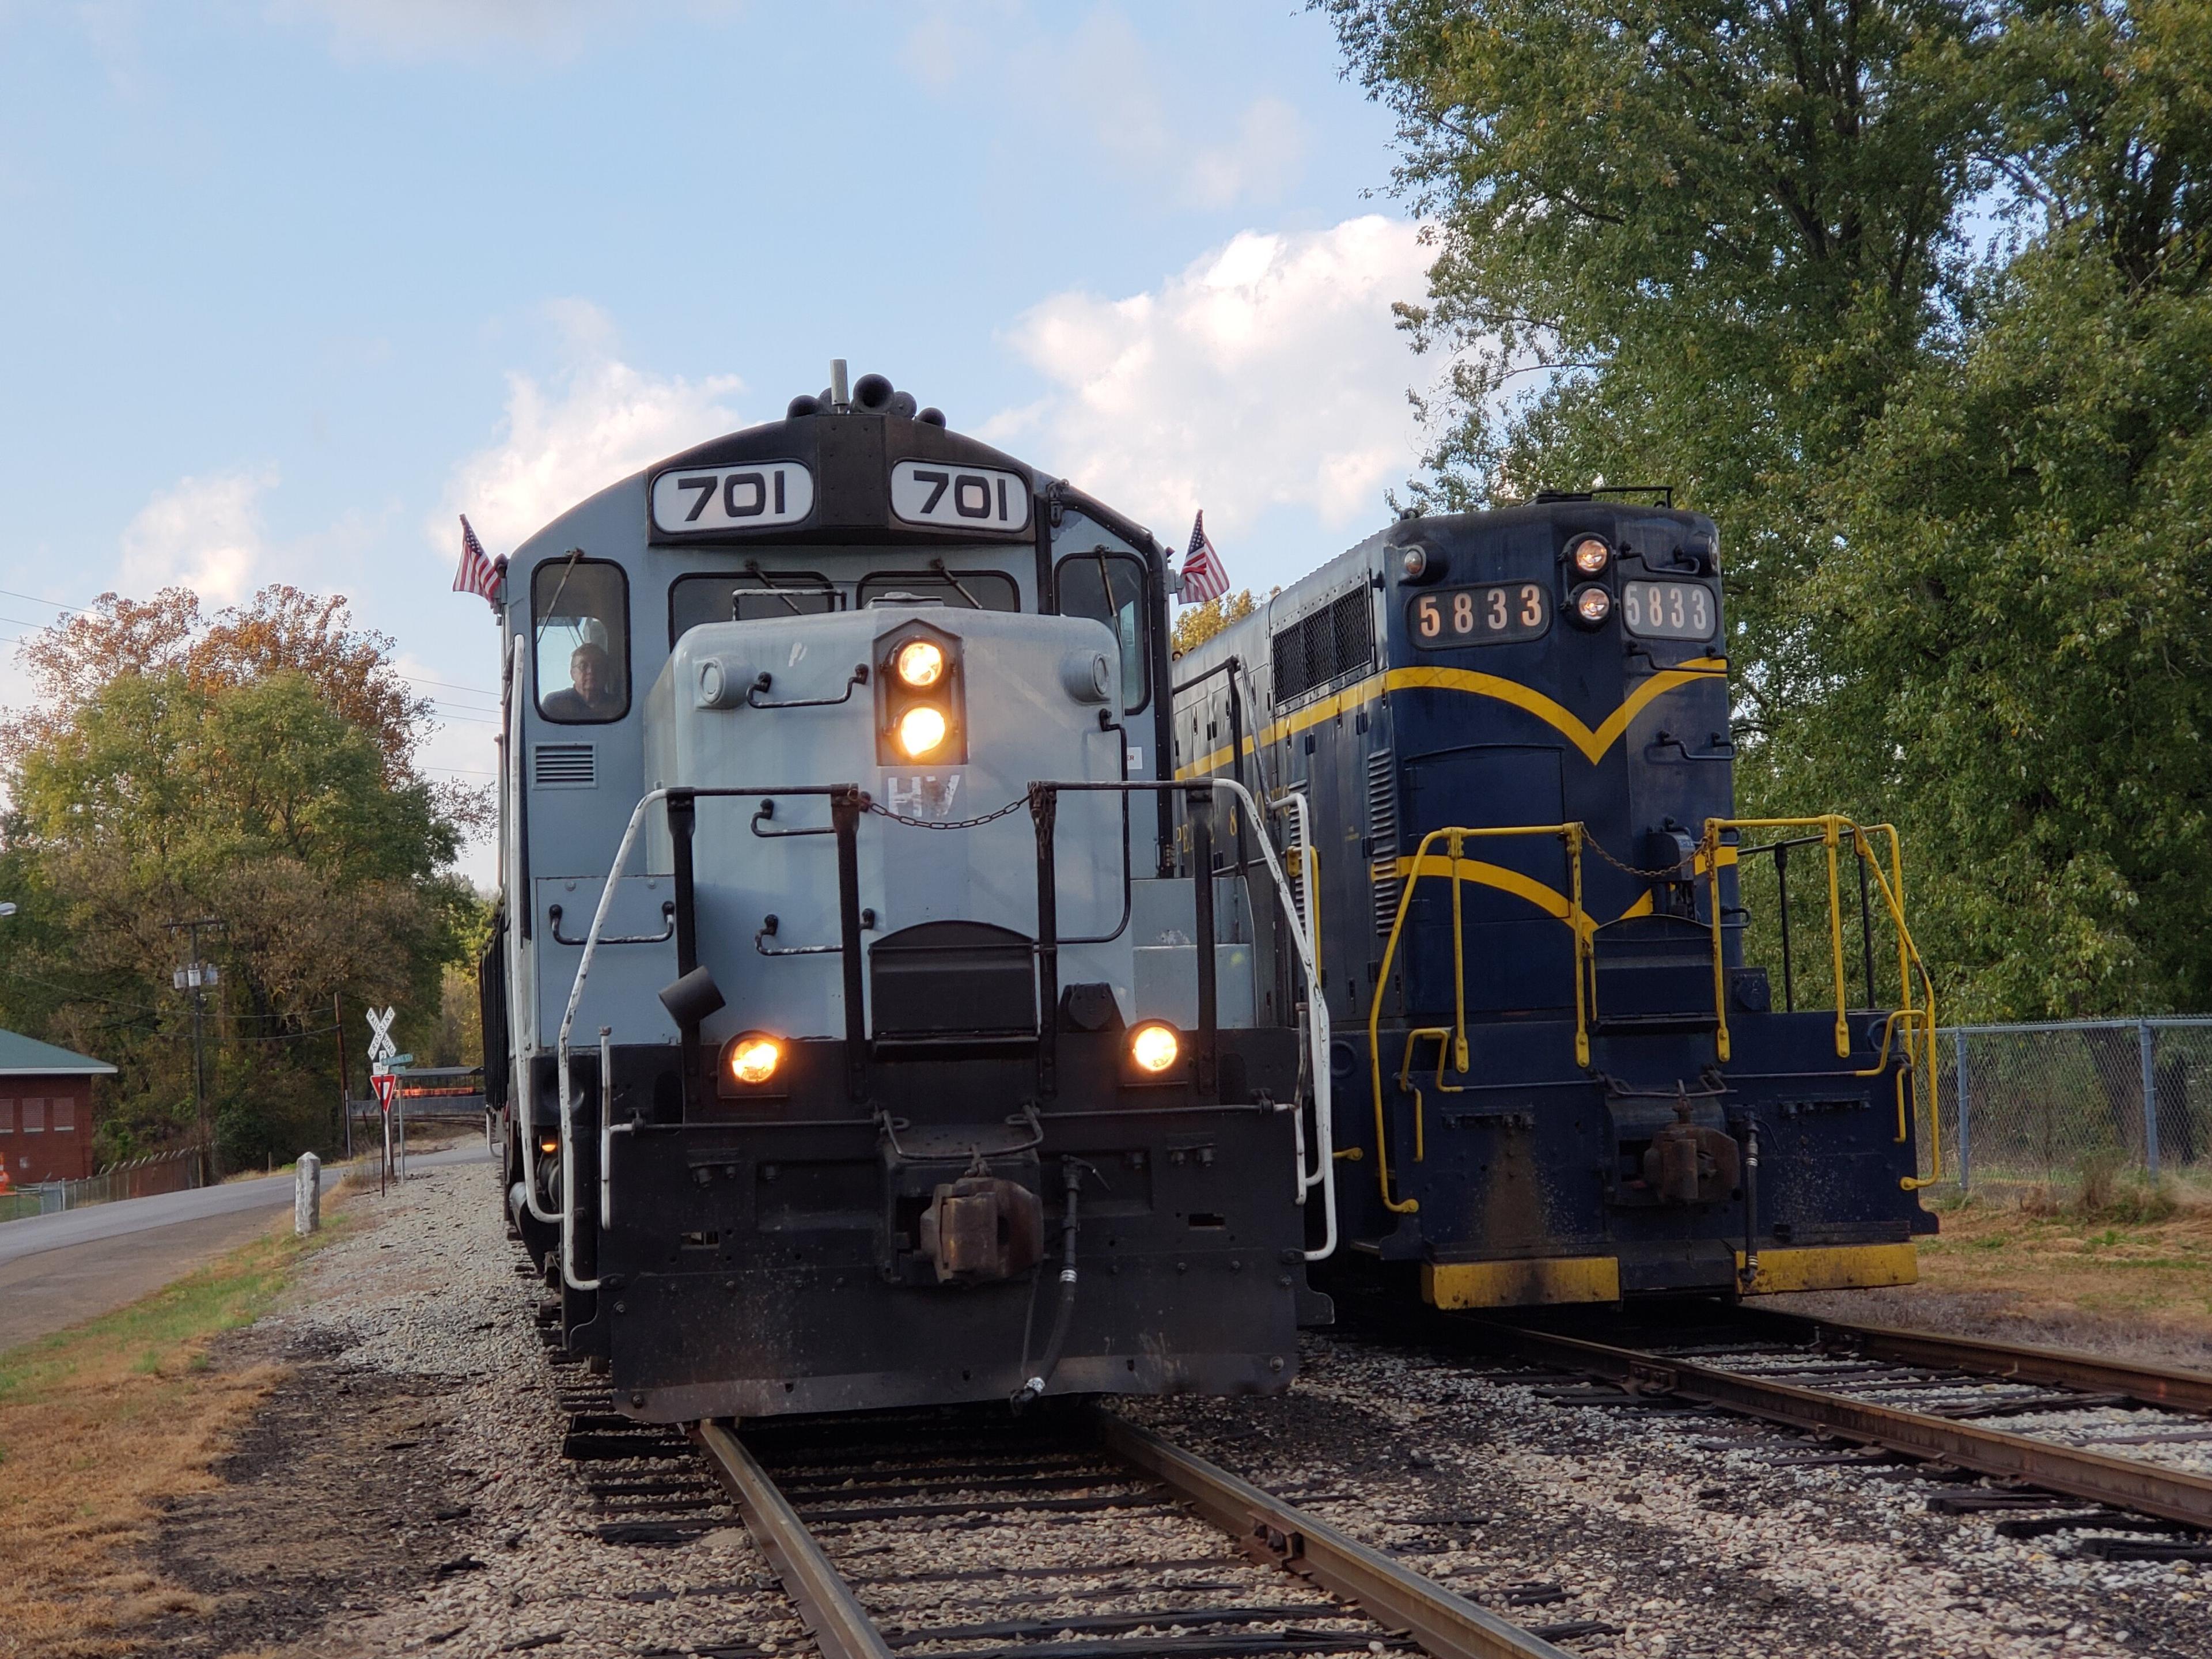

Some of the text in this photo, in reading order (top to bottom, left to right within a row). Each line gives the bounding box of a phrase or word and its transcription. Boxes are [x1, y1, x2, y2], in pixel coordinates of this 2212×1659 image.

[677, 470, 785, 522] 701
[913, 469, 1008, 521] 701
[1419, 582, 1542, 637] 5833
[1625, 584, 1707, 630] 5833
[368, 1010, 394, 1055] RAILROAD
[369, 1009, 393, 1056] CROSSING
